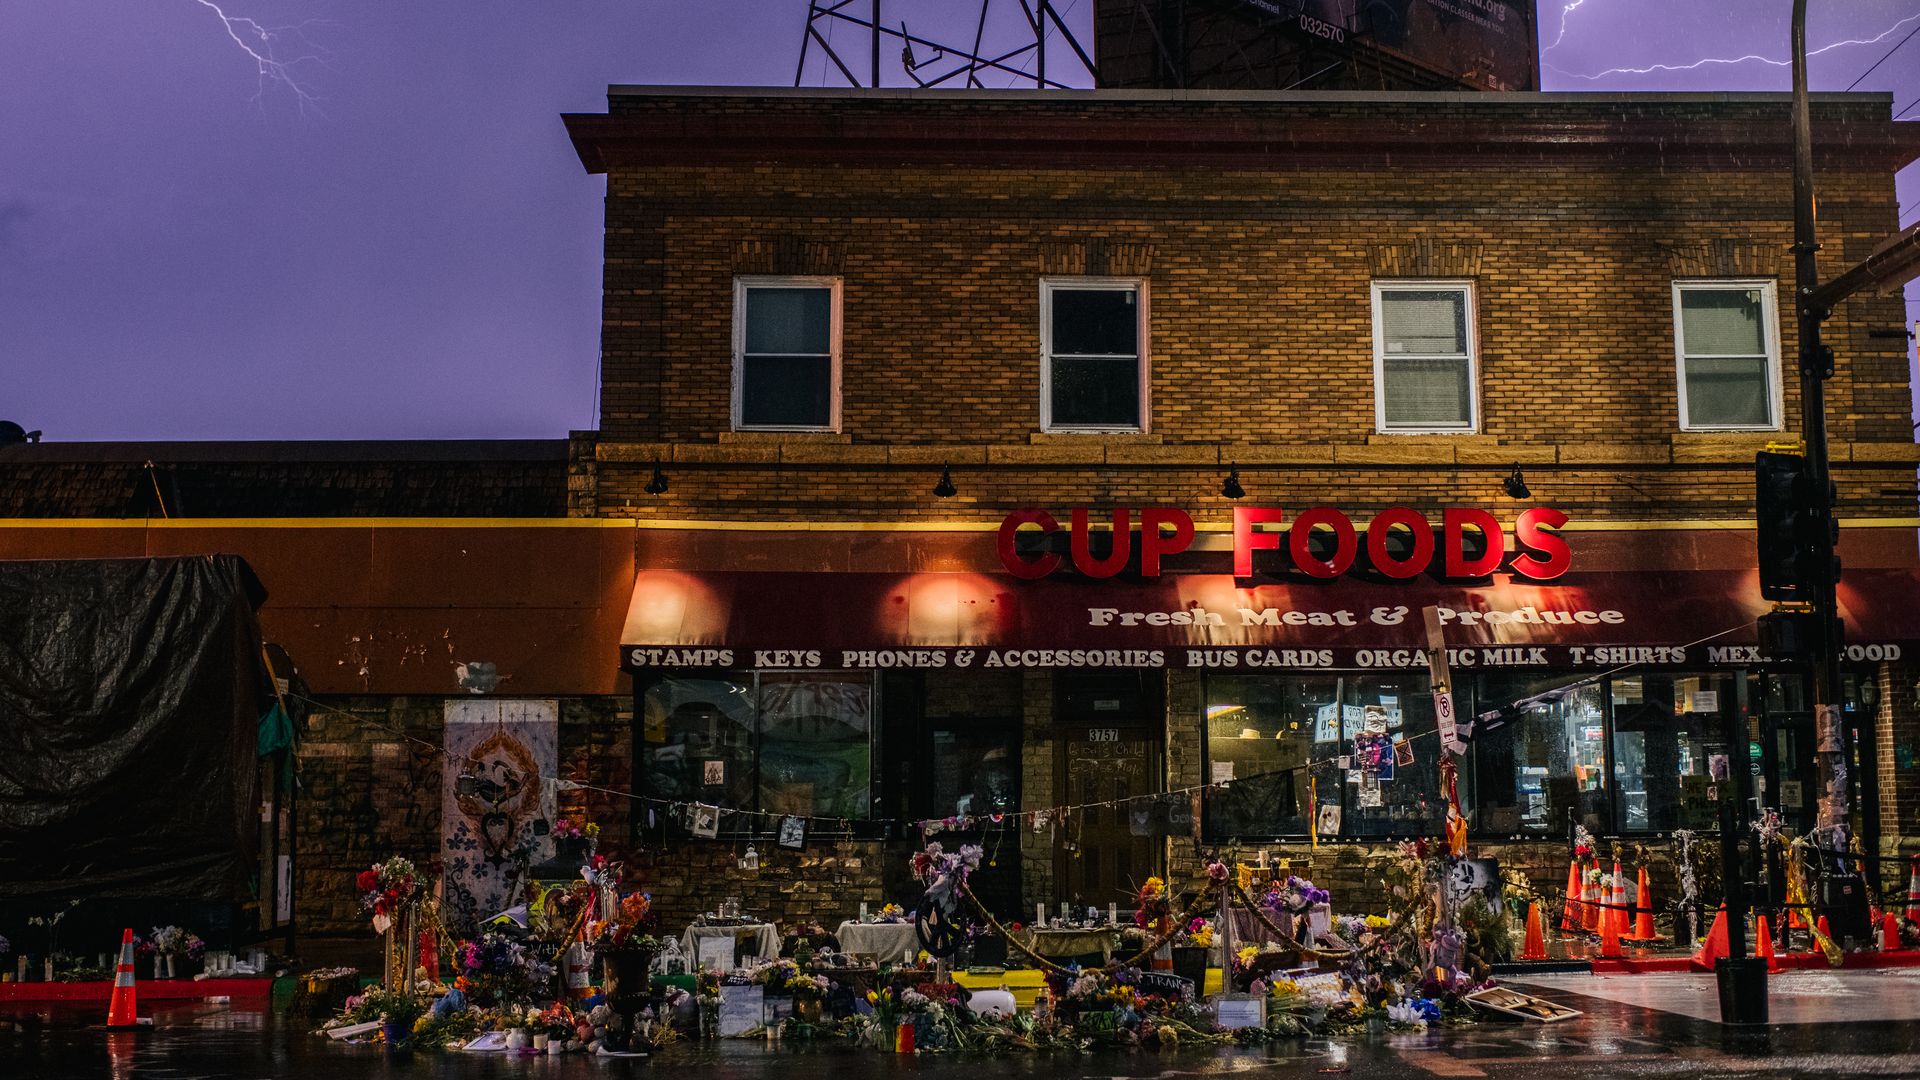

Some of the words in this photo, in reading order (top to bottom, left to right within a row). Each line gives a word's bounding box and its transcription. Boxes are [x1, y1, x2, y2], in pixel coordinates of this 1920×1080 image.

[1300, 14, 1345, 43] 032570
[997, 507, 1195, 579] CUP
[1233, 506, 1573, 580] FOODS
[1088, 608, 1226, 626] Fresh
[1240, 608, 1357, 626] Meat
[1369, 606, 1409, 625] &
[1437, 607, 1626, 625] Produce
[631, 649, 734, 667] STAMPS
[755, 650, 821, 668] KEYS
[842, 650, 947, 668] PHONES
[954, 650, 976, 667] &
[984, 650, 1165, 668] ACCESSORIES
[1187, 650, 1238, 668] BUS
[1245, 649, 1333, 667] CARDS
[1355, 649, 1476, 667] ORGAIC
[1482, 647, 1549, 666] MILK
[1569, 646, 1687, 664] T-SHIRTS
[1090, 730, 1118, 741] 3757
